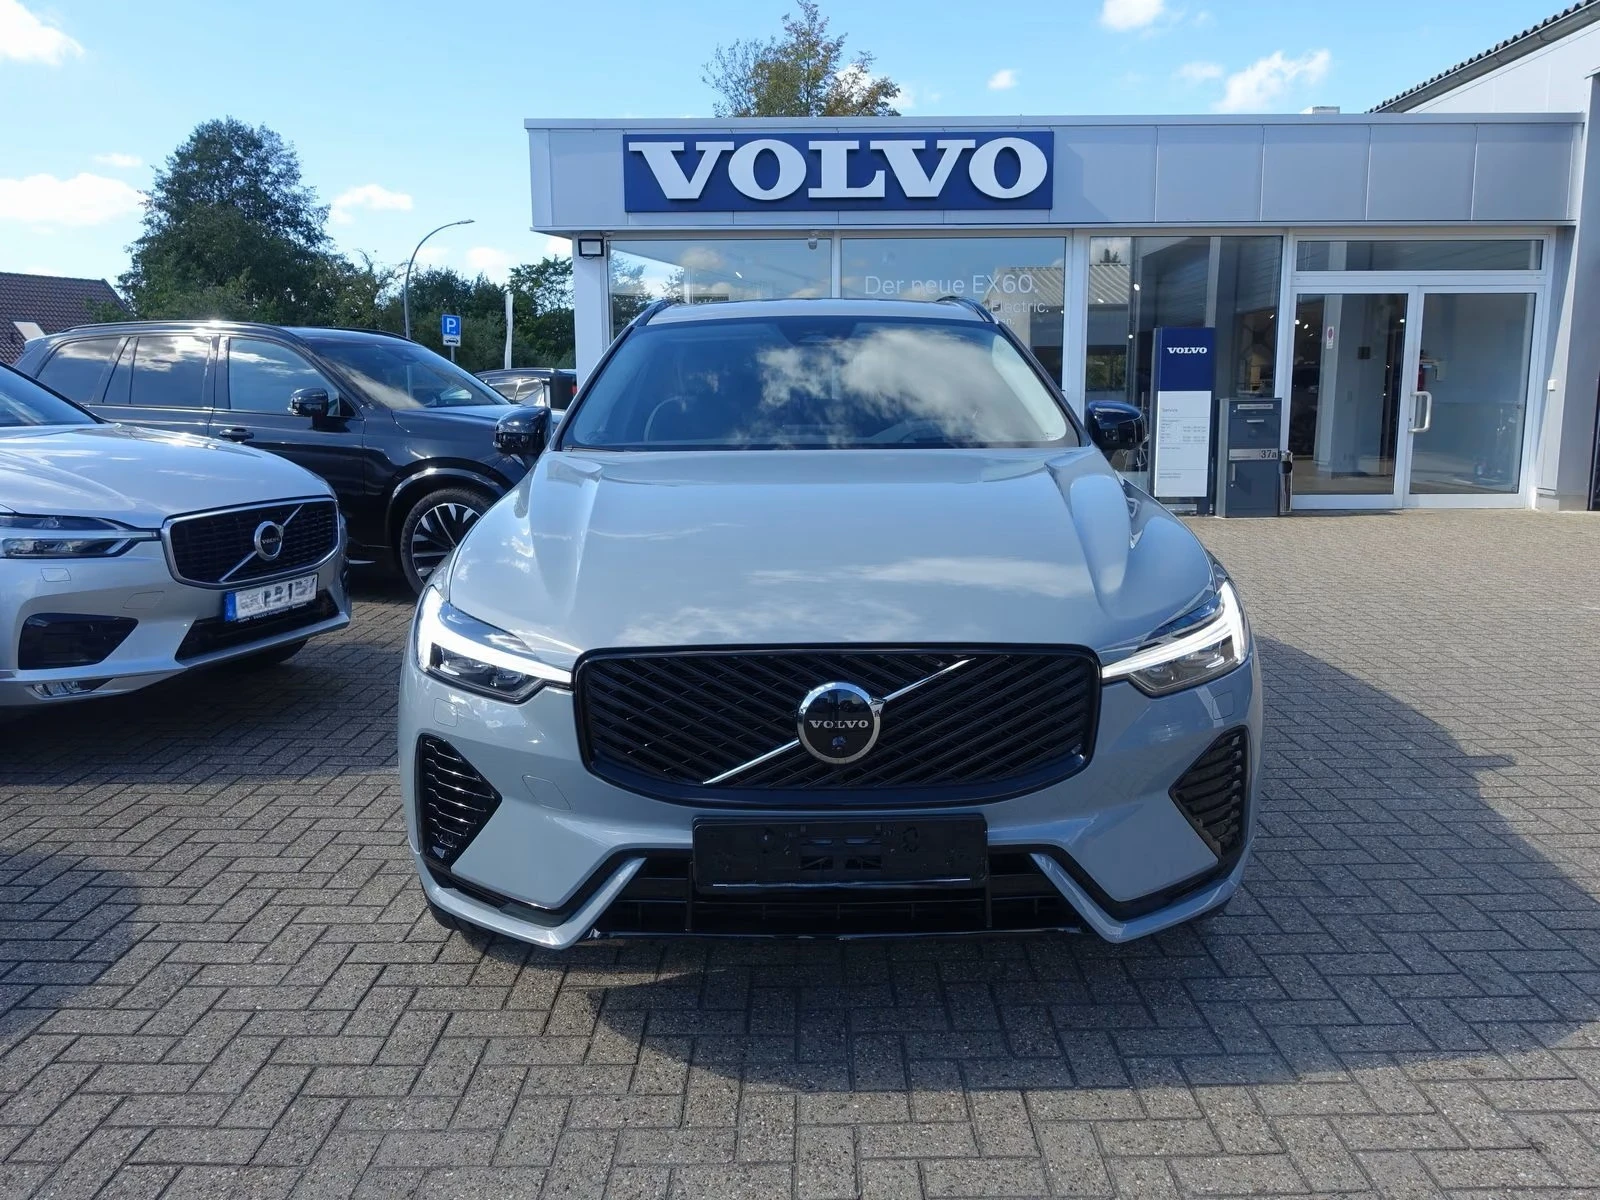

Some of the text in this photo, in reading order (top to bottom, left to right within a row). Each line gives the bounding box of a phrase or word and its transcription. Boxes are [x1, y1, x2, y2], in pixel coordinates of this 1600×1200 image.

[628, 137, 1048, 200] VOLVO
[865, 274, 1039, 295] Der neue EX60.
[990, 300, 1049, 313] Electric.
[446, 317, 457, 333] P
[1260, 450, 1277, 459] 37a
[808, 720, 869, 729] VOLVO
